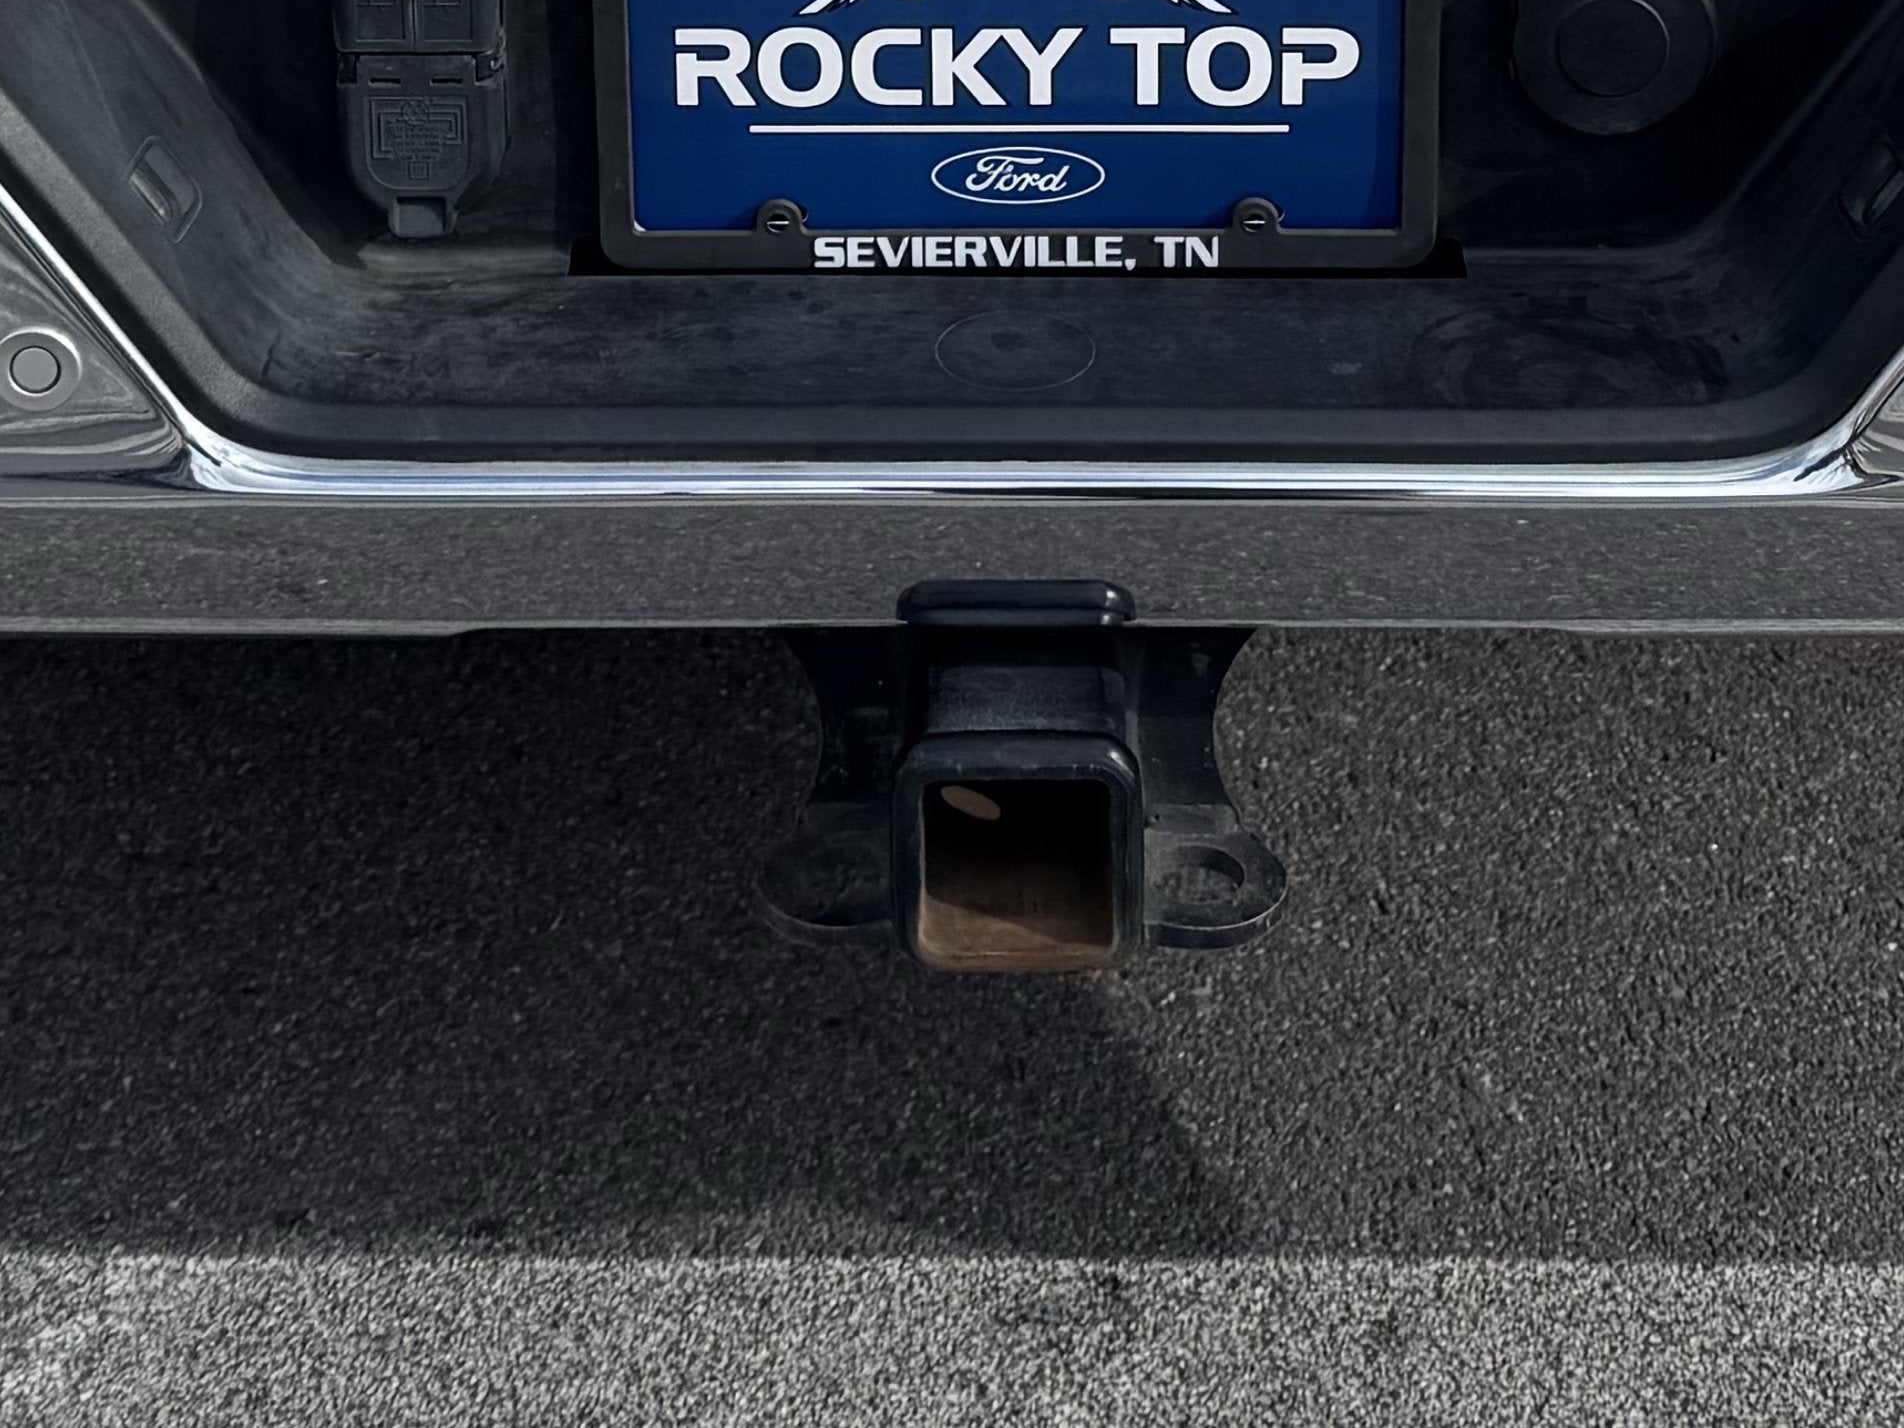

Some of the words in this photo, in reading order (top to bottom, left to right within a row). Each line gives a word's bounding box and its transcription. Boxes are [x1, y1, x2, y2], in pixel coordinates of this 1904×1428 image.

[674, 26, 1085, 107] ROCKY
[1110, 26, 1361, 107] TOP
[964, 155, 1070, 192] Ford
[813, 234, 1137, 271] SEVIERVILLE,
[1153, 234, 1220, 268] TN
